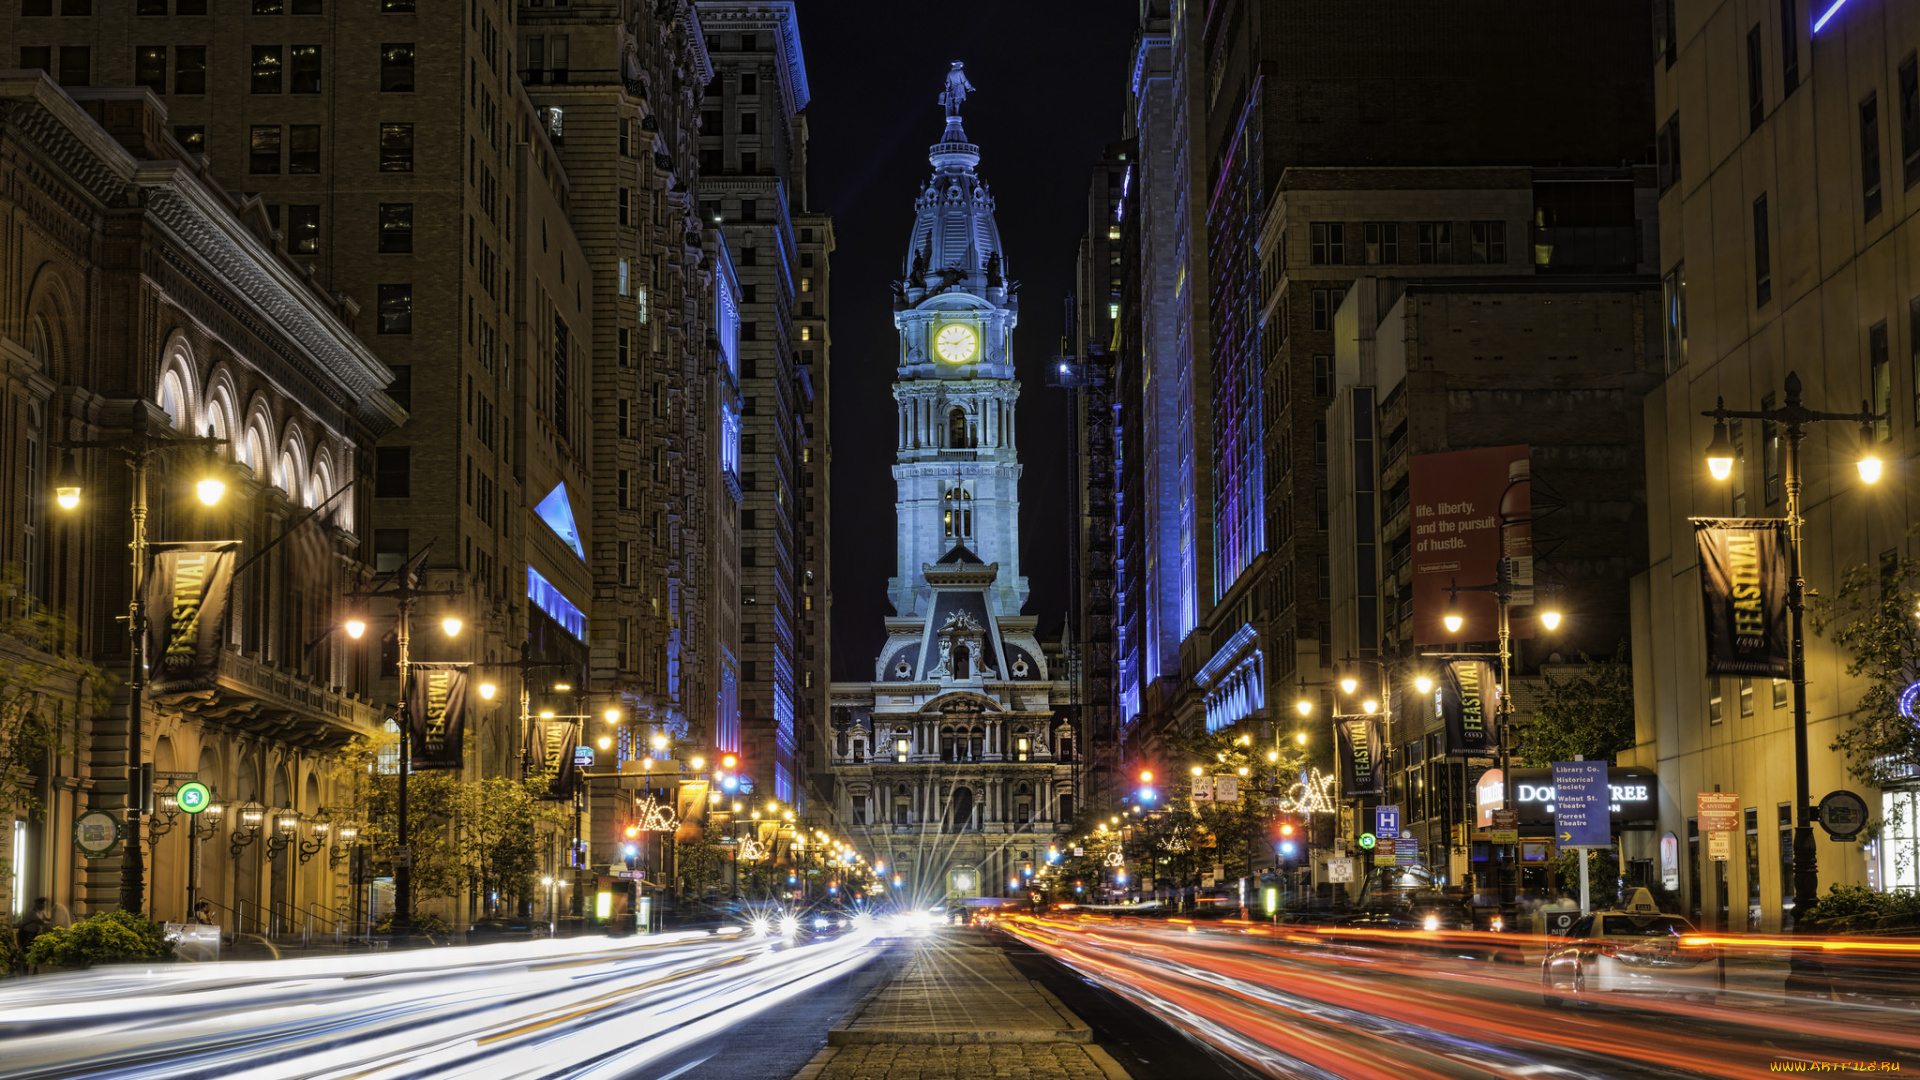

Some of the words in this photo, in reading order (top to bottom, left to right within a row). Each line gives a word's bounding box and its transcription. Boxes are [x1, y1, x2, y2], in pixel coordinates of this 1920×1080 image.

[1415, 504, 1436, 518] life.
[1437, 501, 1476, 516] liberty.
[1416, 521, 1437, 535] and
[1438, 519, 1456, 533] the
[1457, 515, 1496, 534] pursuit
[1416, 538, 1428, 552] of
[1430, 536, 1467, 551] hustle.
[1727, 532, 1765, 637] FEASTIVAL
[1458, 662, 1483, 731] FEASTIVAL
[425, 671, 449, 743] FEASTIVAL
[544, 724, 563, 776] EASTIVAL
[1350, 720, 1371, 777] FEASTIVAL
[1555, 766, 1584, 774] Library
[1557, 783, 1586, 791] Society
[1380, 813, 1395, 827] H
